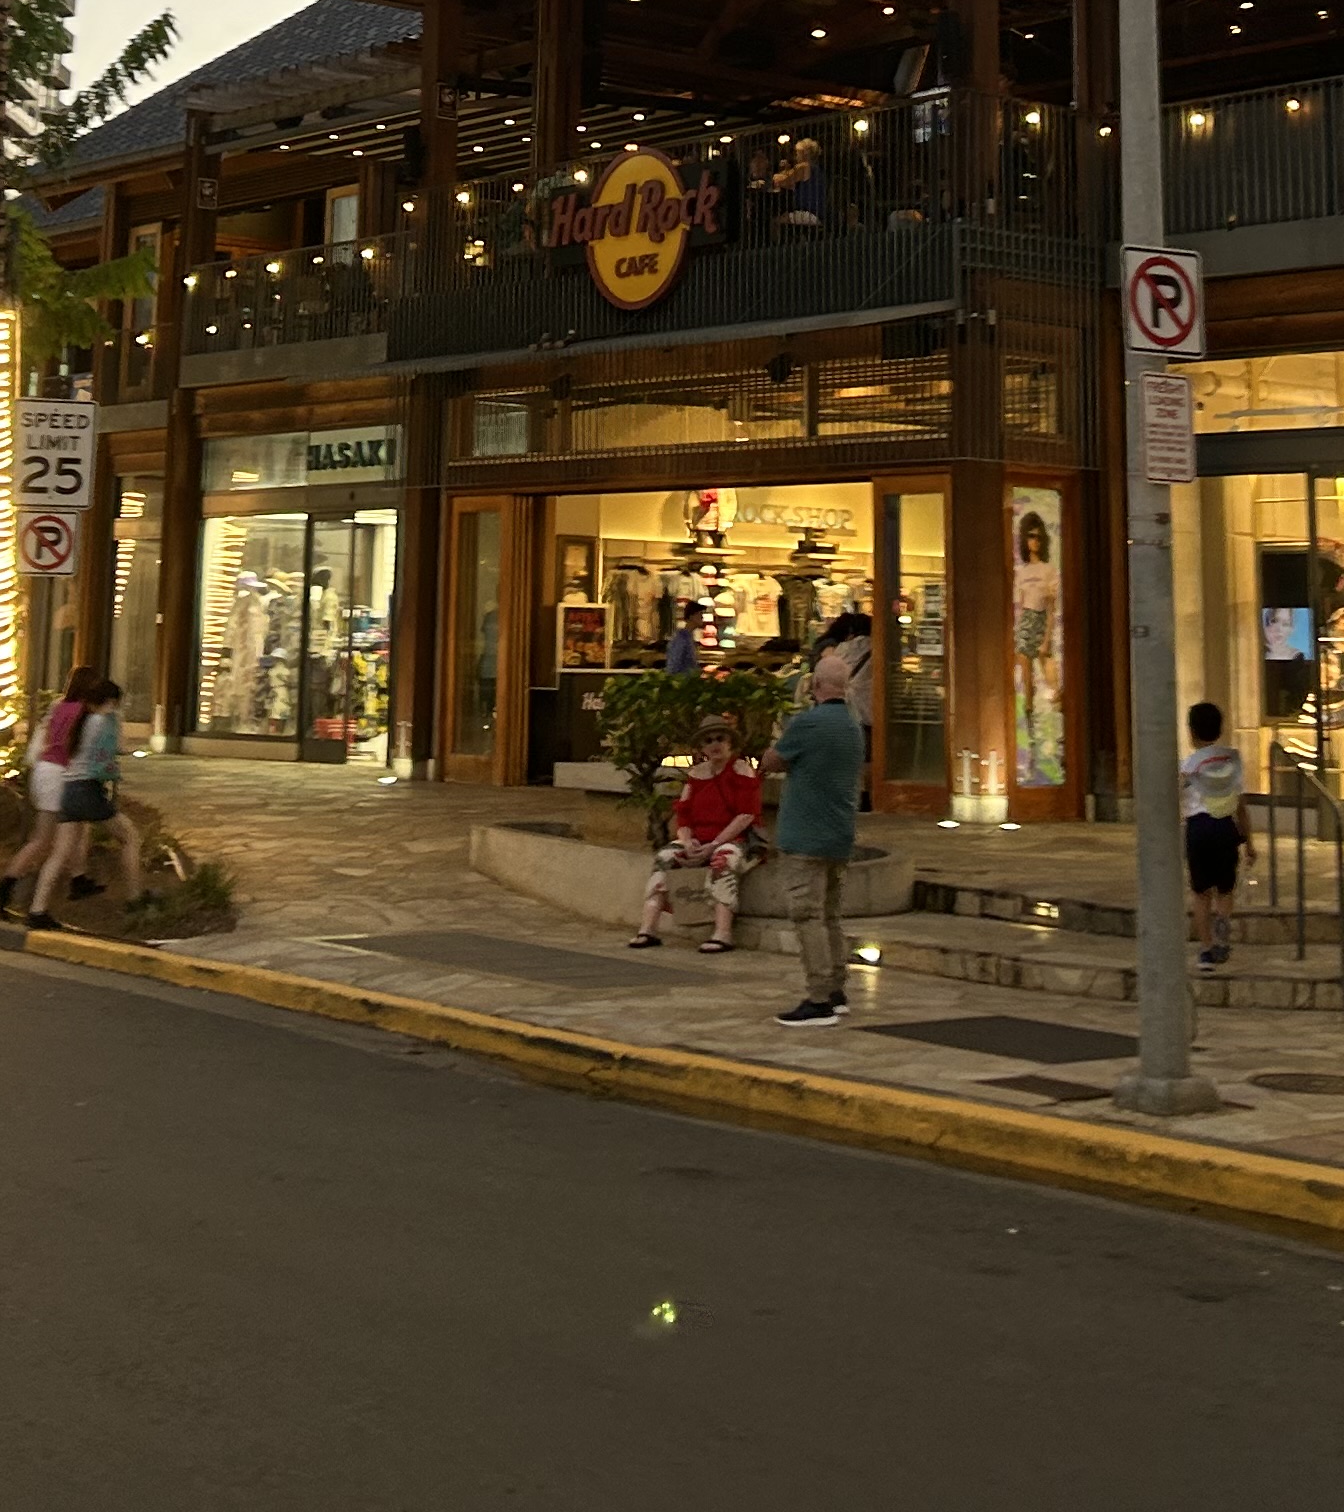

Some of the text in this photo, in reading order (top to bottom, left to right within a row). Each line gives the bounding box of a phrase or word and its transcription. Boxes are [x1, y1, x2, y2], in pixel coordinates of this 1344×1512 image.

[548, 169, 721, 246] Hard Rock
[614, 252, 659, 279] CAFE
[21, 412, 91, 430] SPEED
[26, 434, 81, 452] LIMIT
[20, 455, 84, 496] 25
